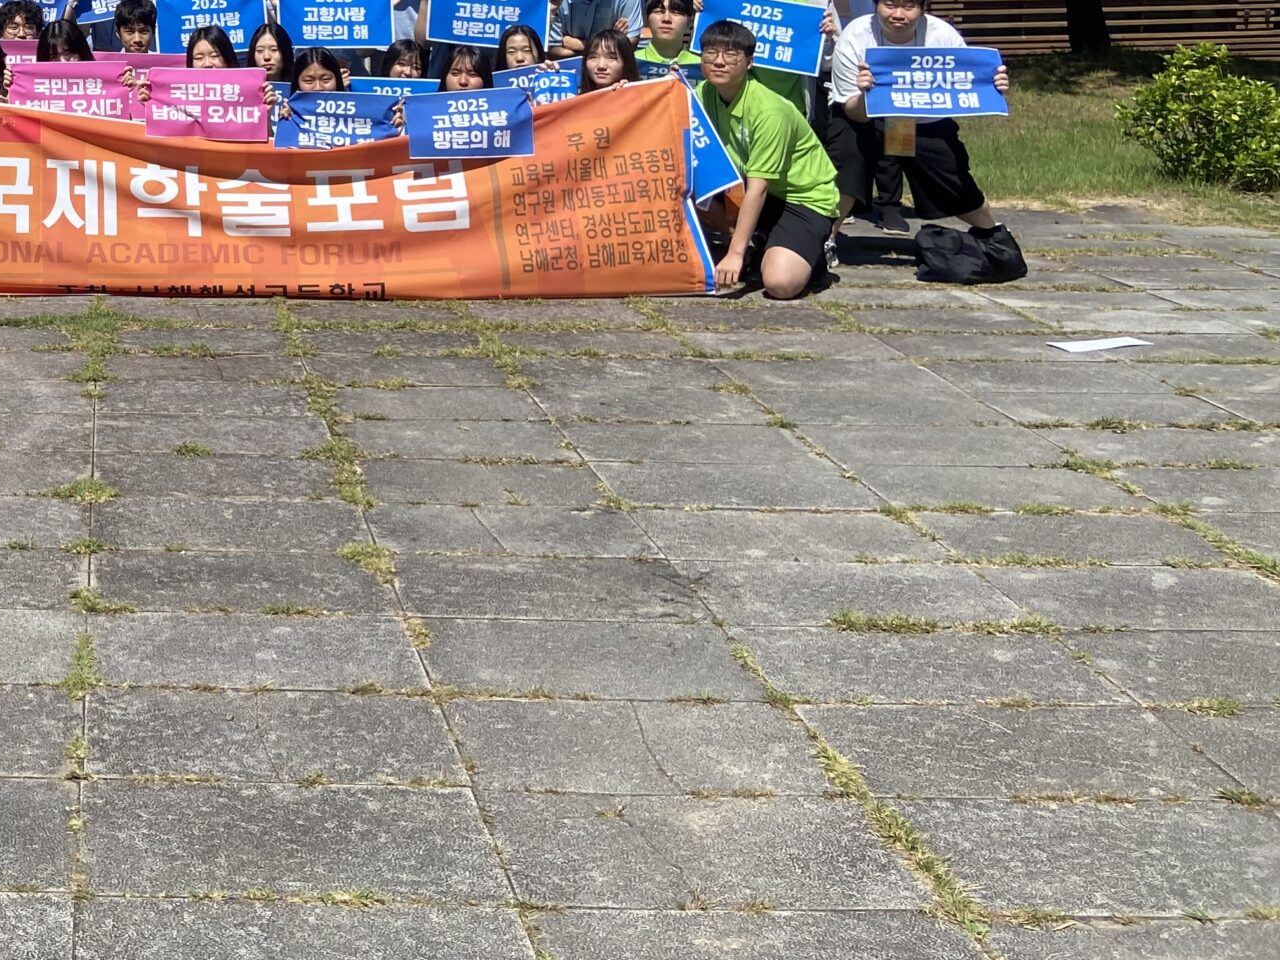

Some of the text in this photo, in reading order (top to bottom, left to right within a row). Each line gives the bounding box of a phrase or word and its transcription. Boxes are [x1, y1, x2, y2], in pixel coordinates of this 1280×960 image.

[181, 12, 240, 30] 고향사랑
[304, 7, 366, 22] 고향사랑
[455, 2, 520, 22] 고향사랑
[740, 3, 783, 21] 2025
[302, 25, 368, 40] 방문의 해
[452, 20, 500, 38] 방문의
[774, 45, 793, 63] 해
[910, 56, 955, 69] 2025
[33, 78, 107, 96] 국민고향,
[891, 71, 975, 90] 고향사랑
[170, 83, 244, 102] 국민고향,
[890, 92, 980, 109] 방문의 해
[316, 100, 356, 114] 2025
[447, 98, 489, 112] 2025
[151, 105, 202, 121] 남해로
[208, 105, 261, 124] 오시다
[432, 111, 508, 129] 고향사랑
[300, 114, 373, 135] 고향사랑
[432, 130, 511, 149] 방문의 해
[510, 161, 560, 187] 교육부,
[565, 157, 608, 183] 서울대
[613, 148, 676, 177] 교육종합
[513, 190, 555, 216] 연구원
[86, 241, 265, 266] ACADEMIC
[281, 241, 403, 266] FORUM
